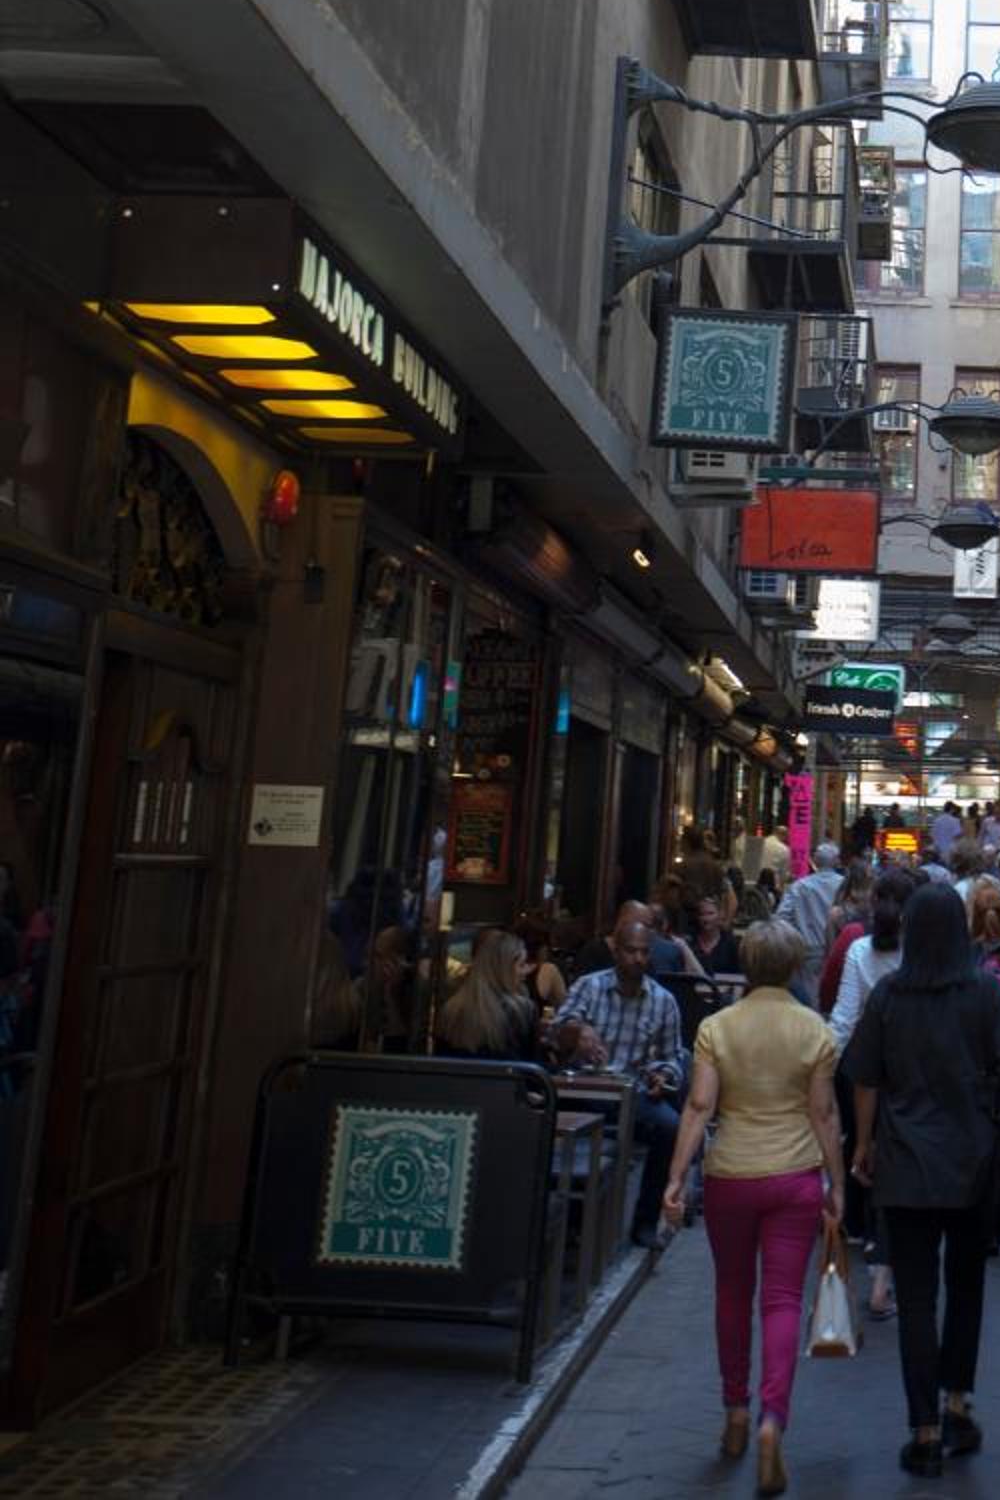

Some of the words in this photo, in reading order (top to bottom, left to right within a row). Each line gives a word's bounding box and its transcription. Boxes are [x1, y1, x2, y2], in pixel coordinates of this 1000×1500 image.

[299, 238, 385, 367] MAJORCA
[691, 408, 747, 431] FIVE
[388, 1159, 411, 1195] 5
[357, 1227, 425, 1253] FIVE
